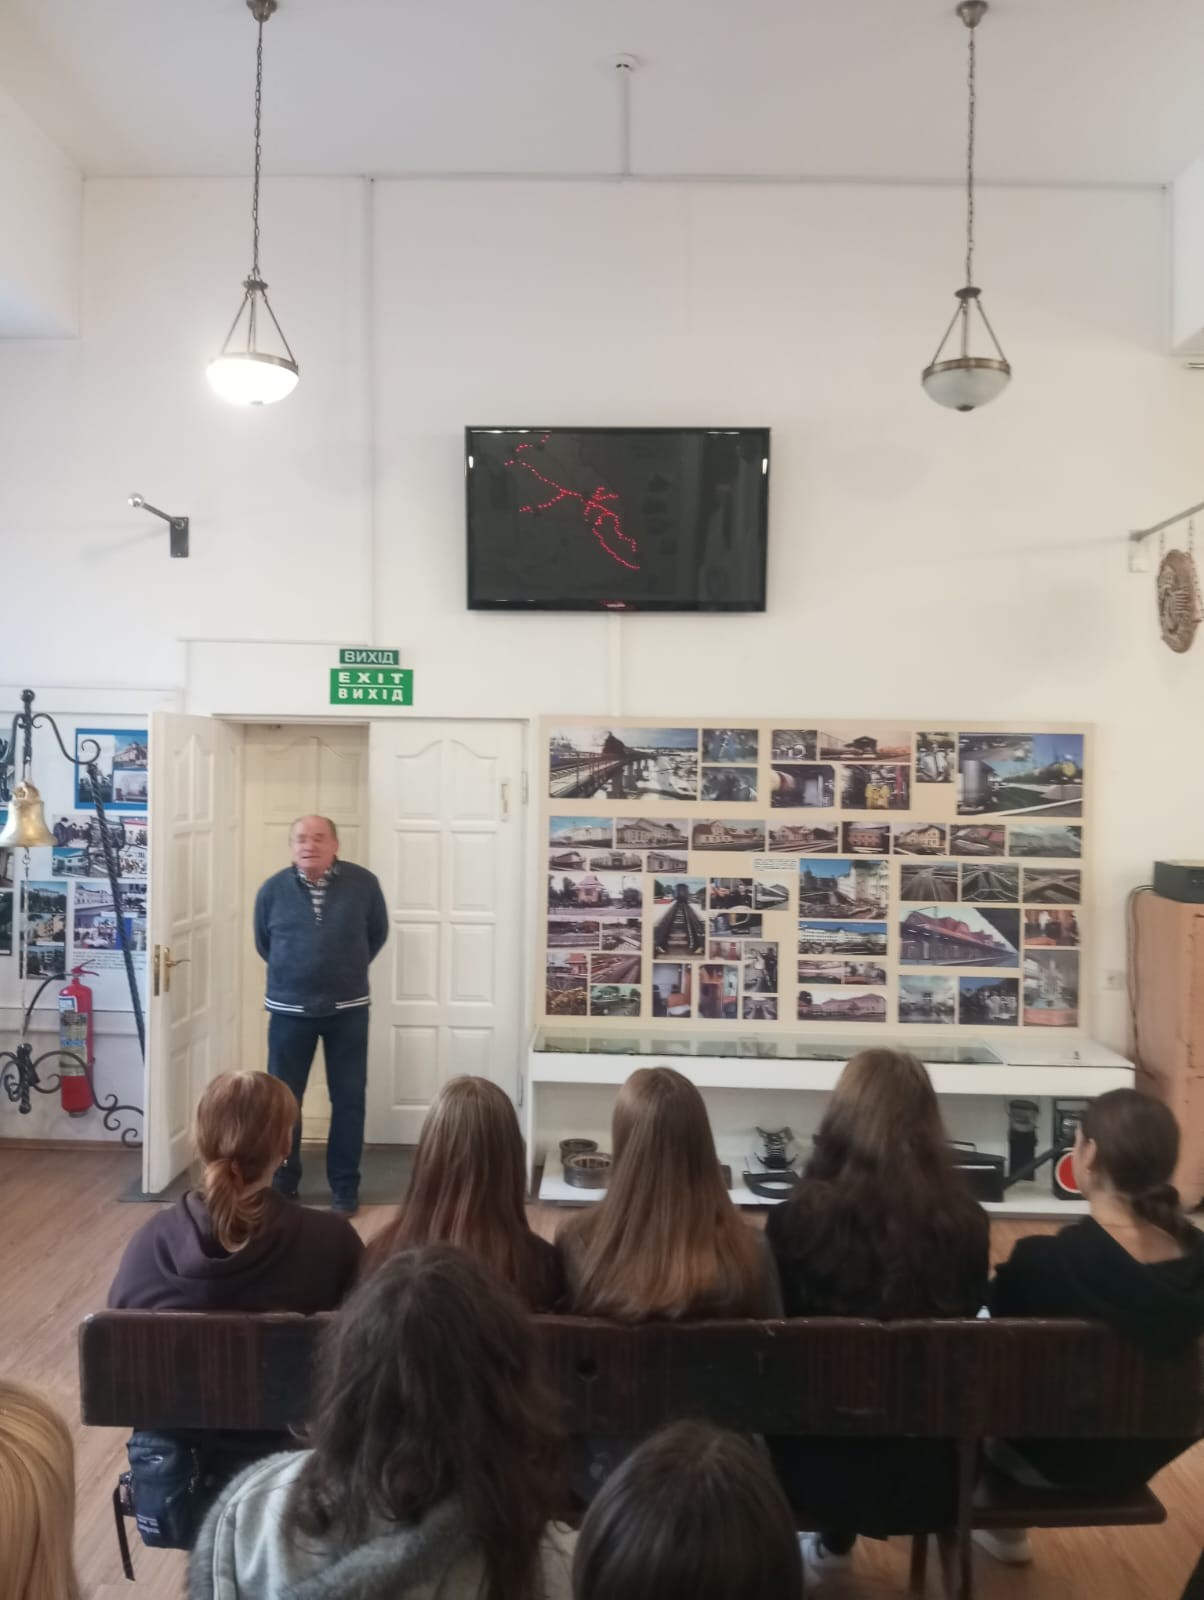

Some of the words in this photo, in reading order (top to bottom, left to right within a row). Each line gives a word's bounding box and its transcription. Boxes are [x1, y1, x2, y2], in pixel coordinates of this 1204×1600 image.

[344, 651, 394, 664] ВИХІД
[339, 672, 404, 684] EXIT
[338, 688, 404, 702] ВИХІД
